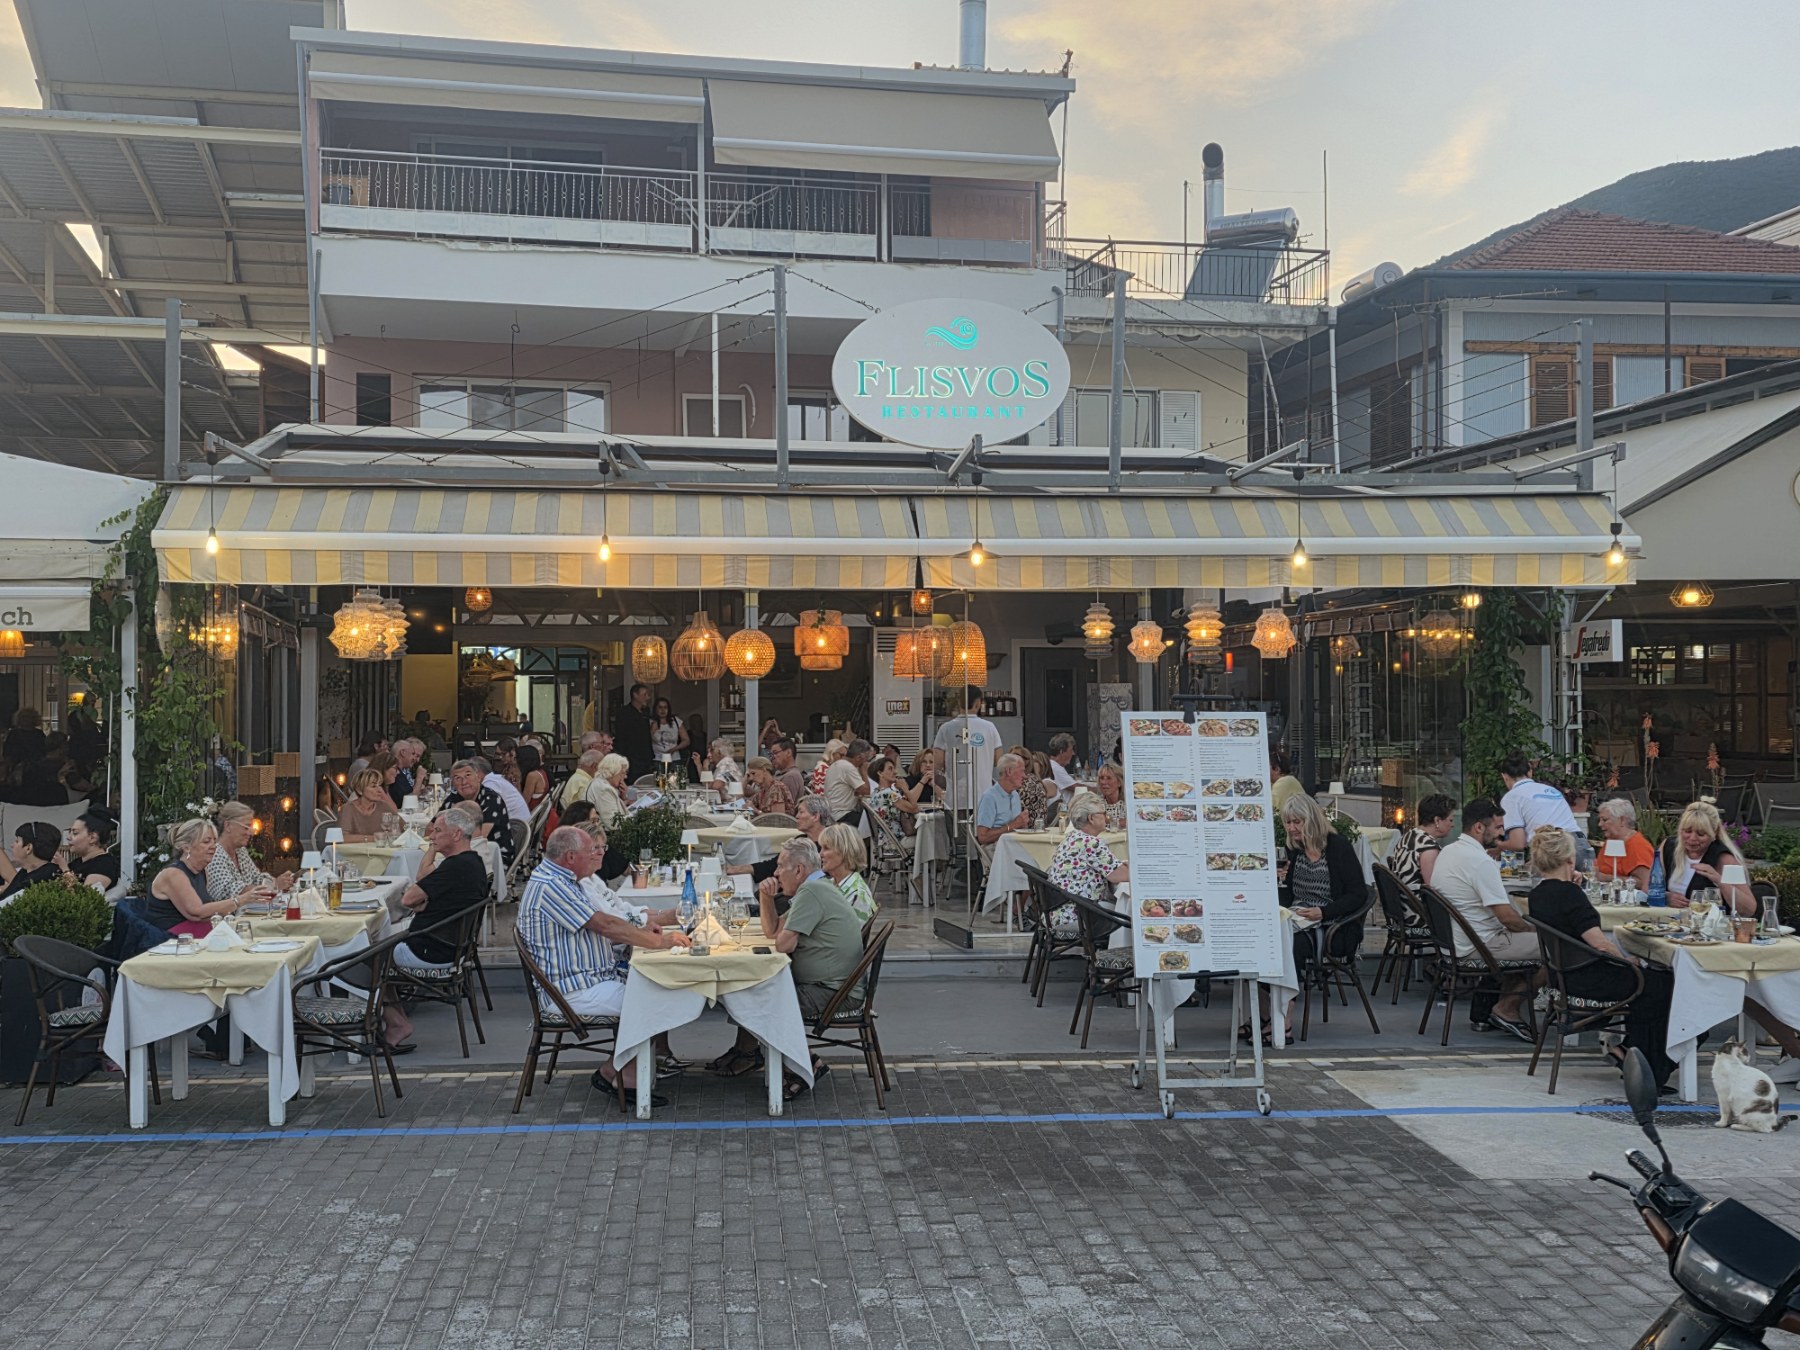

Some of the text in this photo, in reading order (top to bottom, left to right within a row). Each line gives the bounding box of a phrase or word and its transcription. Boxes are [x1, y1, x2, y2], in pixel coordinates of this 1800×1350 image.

[853, 359, 1050, 399] FLISVOS
[882, 405, 1026, 420] RESTAURANT
[1, 606, 34, 626] ch
[1572, 626, 1611, 660] Segafredo
